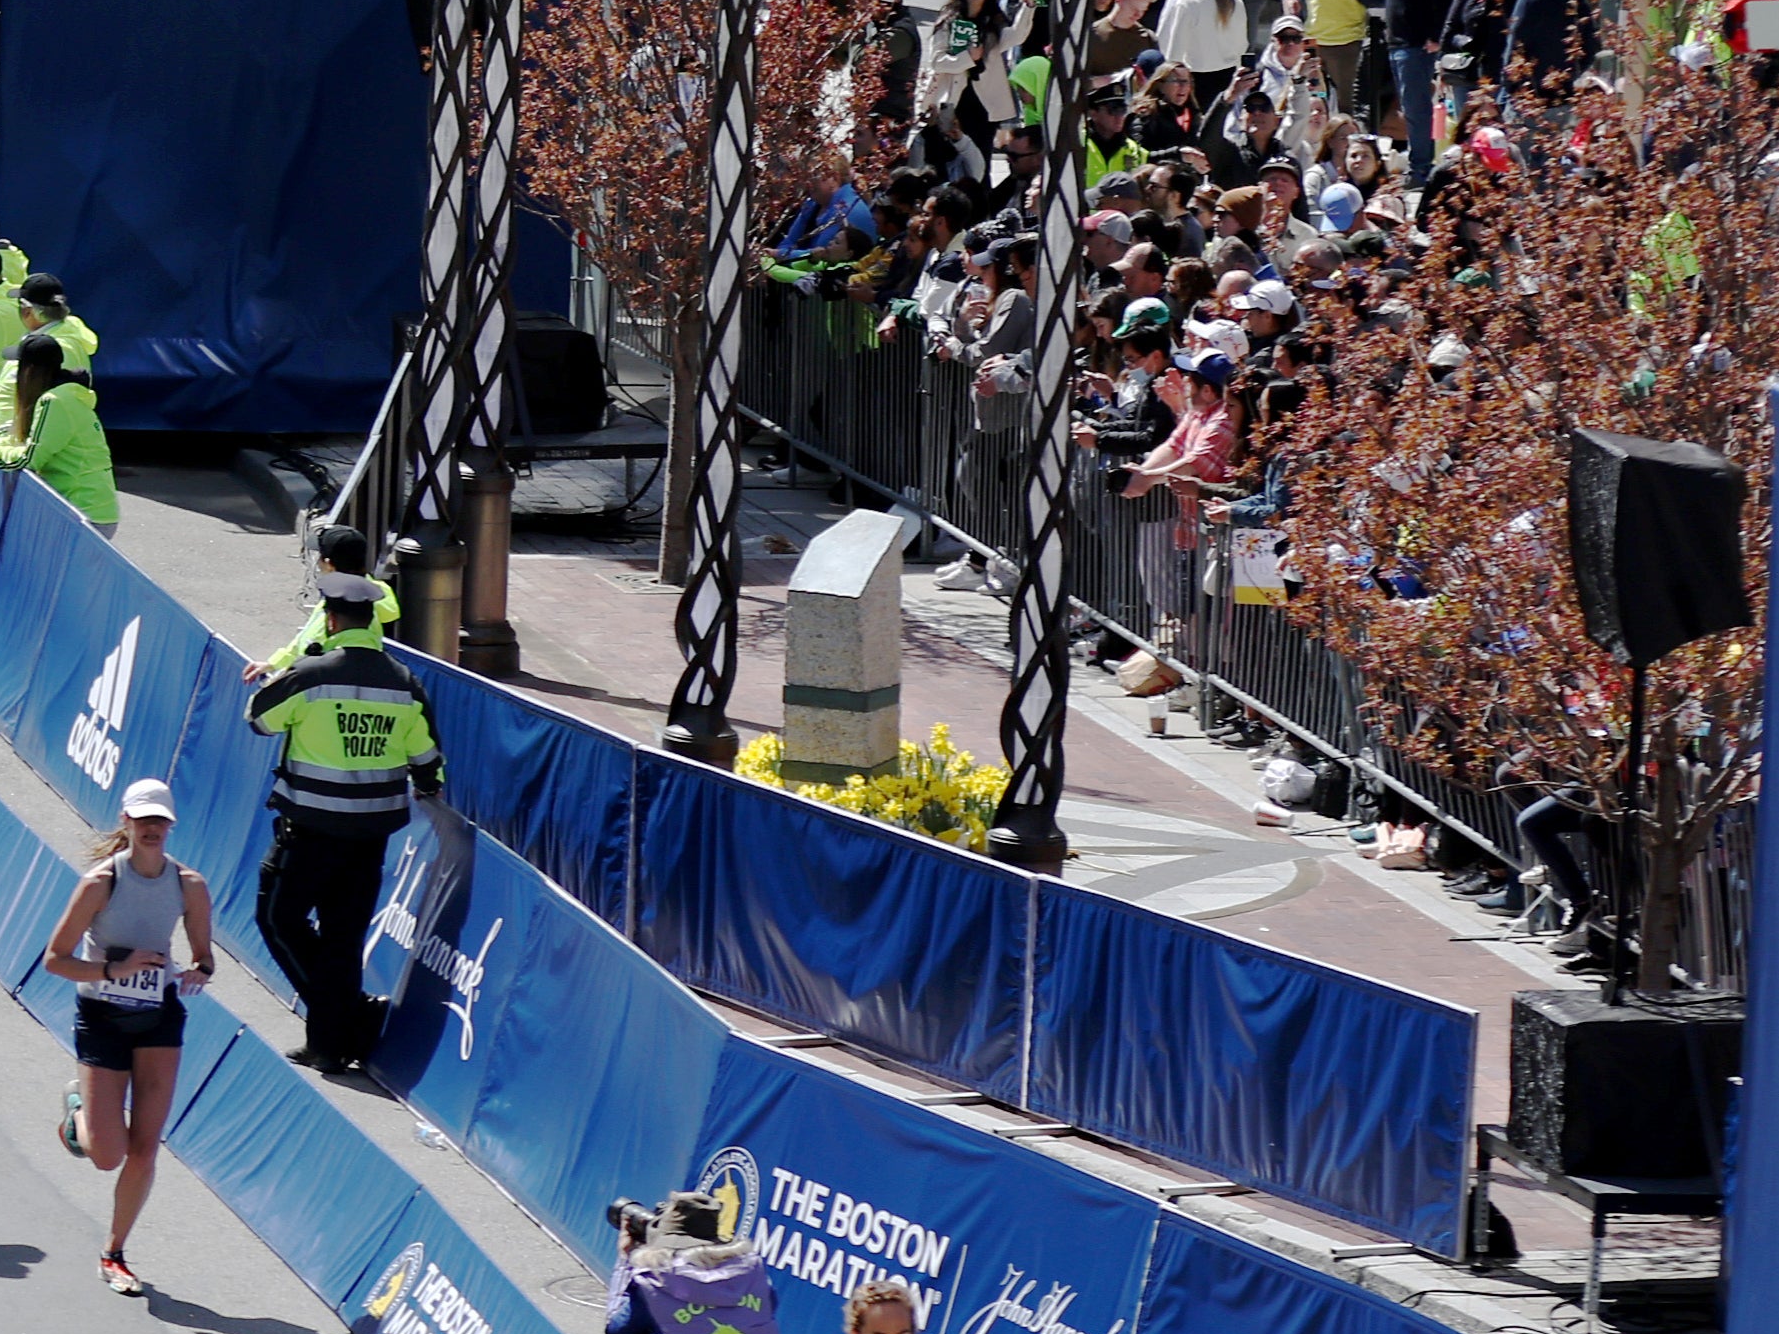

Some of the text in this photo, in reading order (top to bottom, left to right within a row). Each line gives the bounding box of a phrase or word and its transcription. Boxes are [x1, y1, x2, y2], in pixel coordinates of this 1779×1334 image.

[66, 711, 120, 791] adidas
[336, 713, 396, 735] BOSTON
[770, 1166, 831, 1230] THE
[825, 1192, 951, 1279] BOSTON
[413, 1261, 446, 1310] THE
